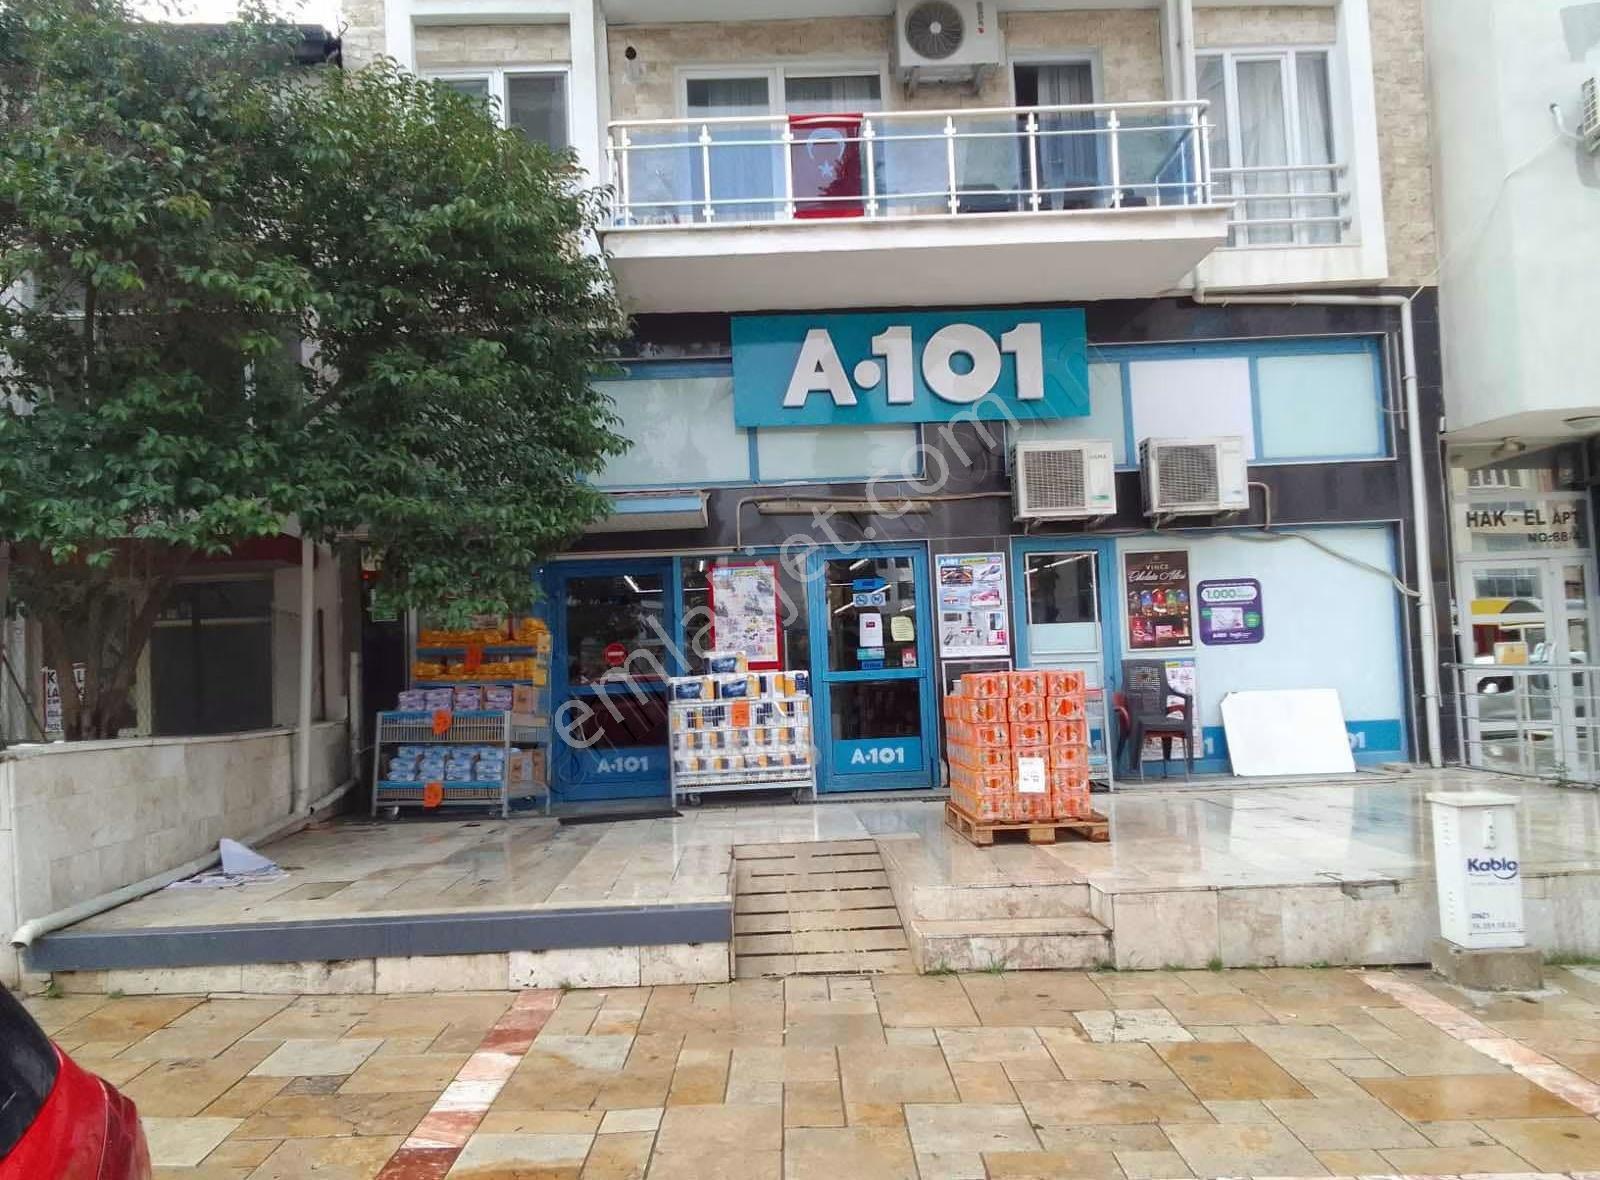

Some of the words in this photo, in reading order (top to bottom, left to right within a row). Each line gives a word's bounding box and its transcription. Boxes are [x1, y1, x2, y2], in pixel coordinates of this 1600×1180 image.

[1466, 510, 1506, 527] HAK
[1524, 509, 1546, 526] EL
[1467, 857, 1518, 872] Kablo
